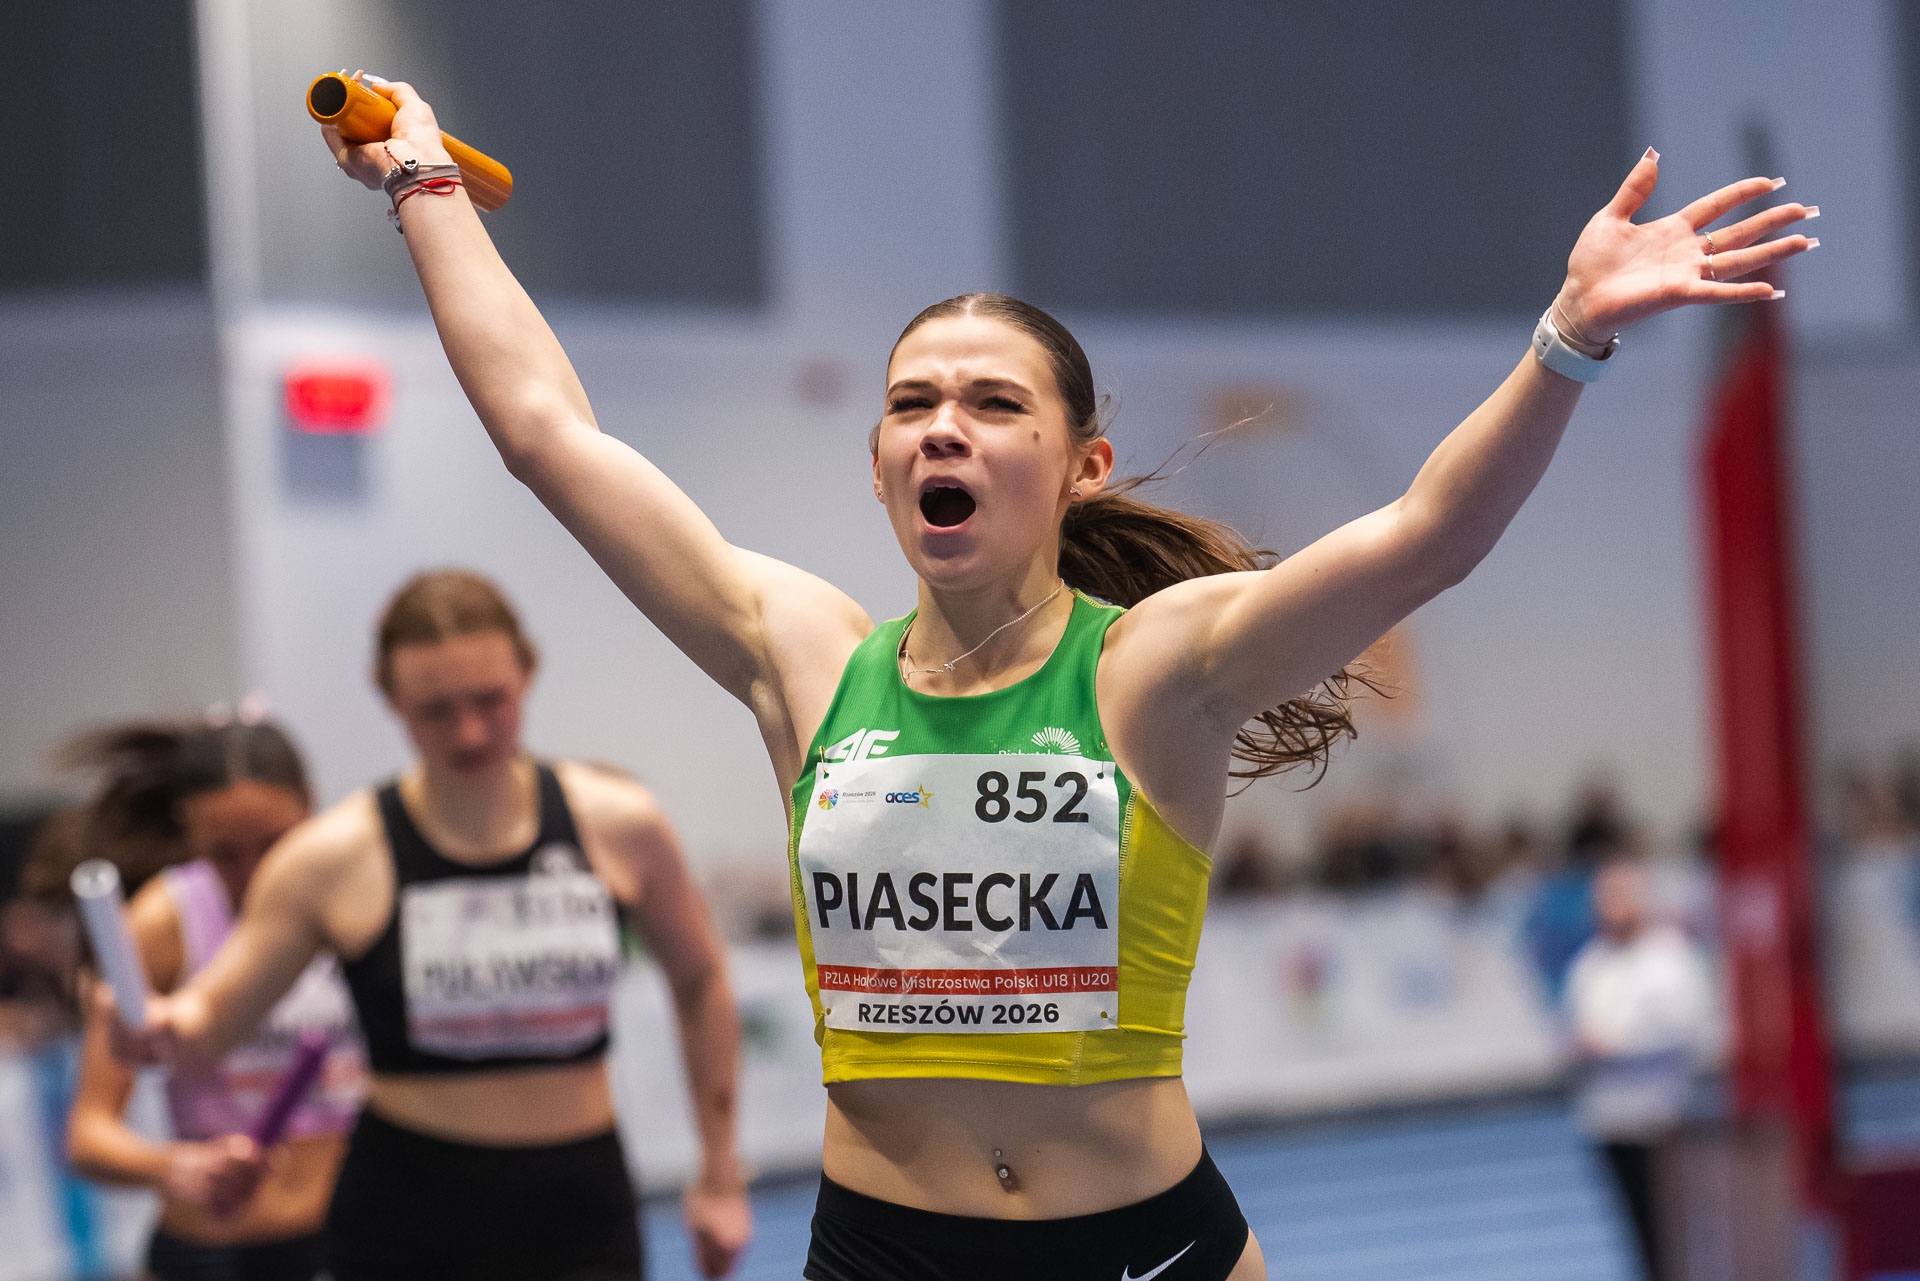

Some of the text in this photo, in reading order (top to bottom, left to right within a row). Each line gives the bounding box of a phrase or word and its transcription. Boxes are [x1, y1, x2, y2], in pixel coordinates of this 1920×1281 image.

[885, 792, 920, 803] aces
[975, 770, 1089, 823] 852
[813, 872, 1108, 931] PIASECKA
[825, 971, 1110, 989] PZLA Halowe Mistrzostwa Polski U18 i U20
[858, 998, 1060, 1025] RZESZÓW 2026
